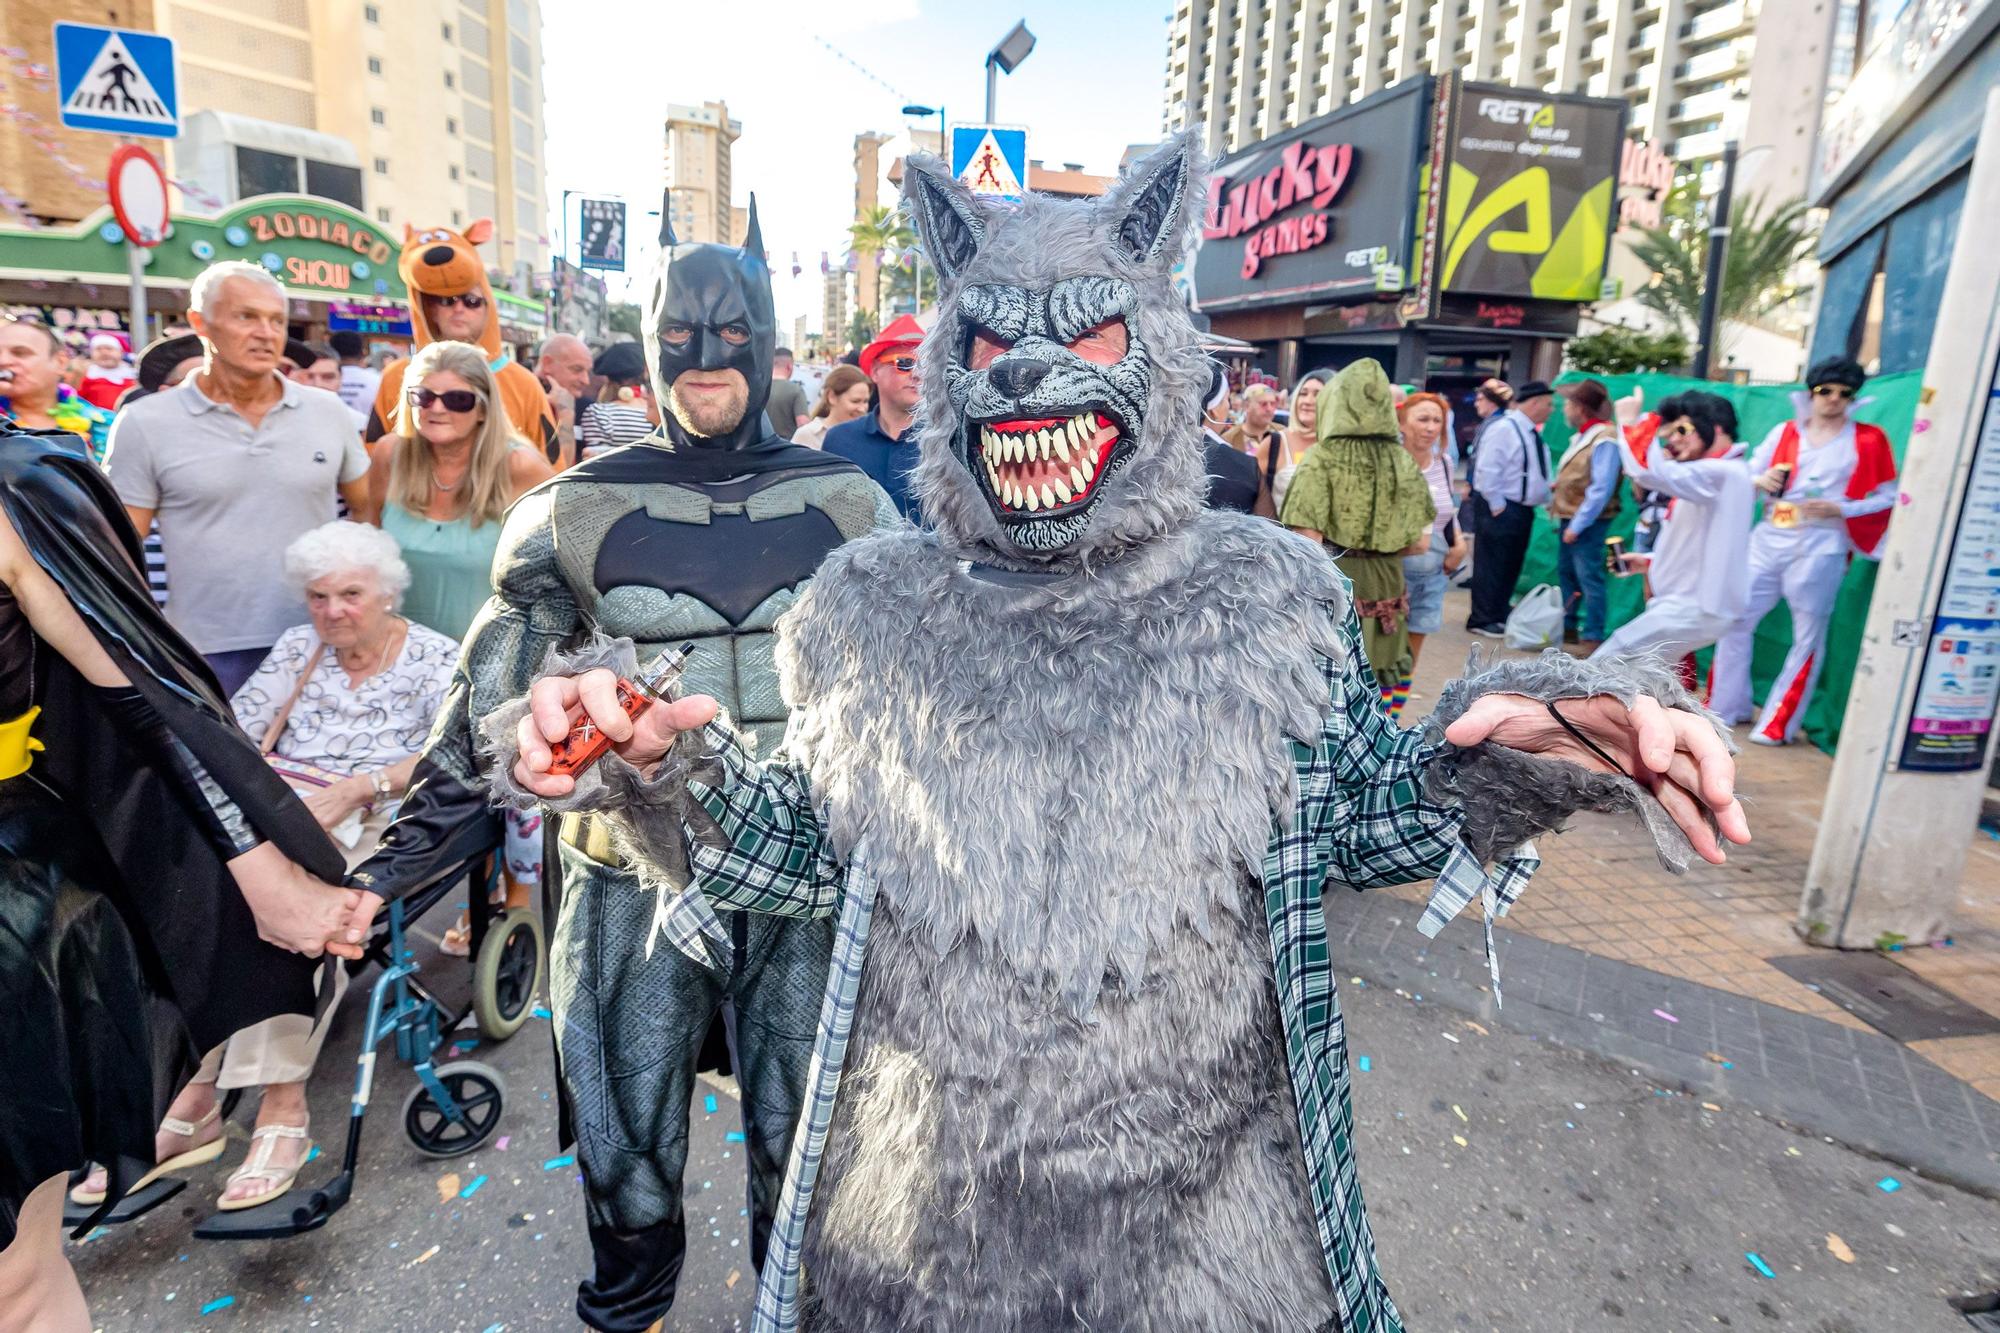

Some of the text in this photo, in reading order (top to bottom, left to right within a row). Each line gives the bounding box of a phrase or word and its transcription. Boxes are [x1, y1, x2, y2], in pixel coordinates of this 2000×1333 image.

[1478, 98, 1554, 131] RETA
[1202, 139, 1354, 240] Lucky
[248, 212, 390, 264] ZODIACO
[1240, 213, 1328, 280] games
[286, 256, 350, 289] SHOW
